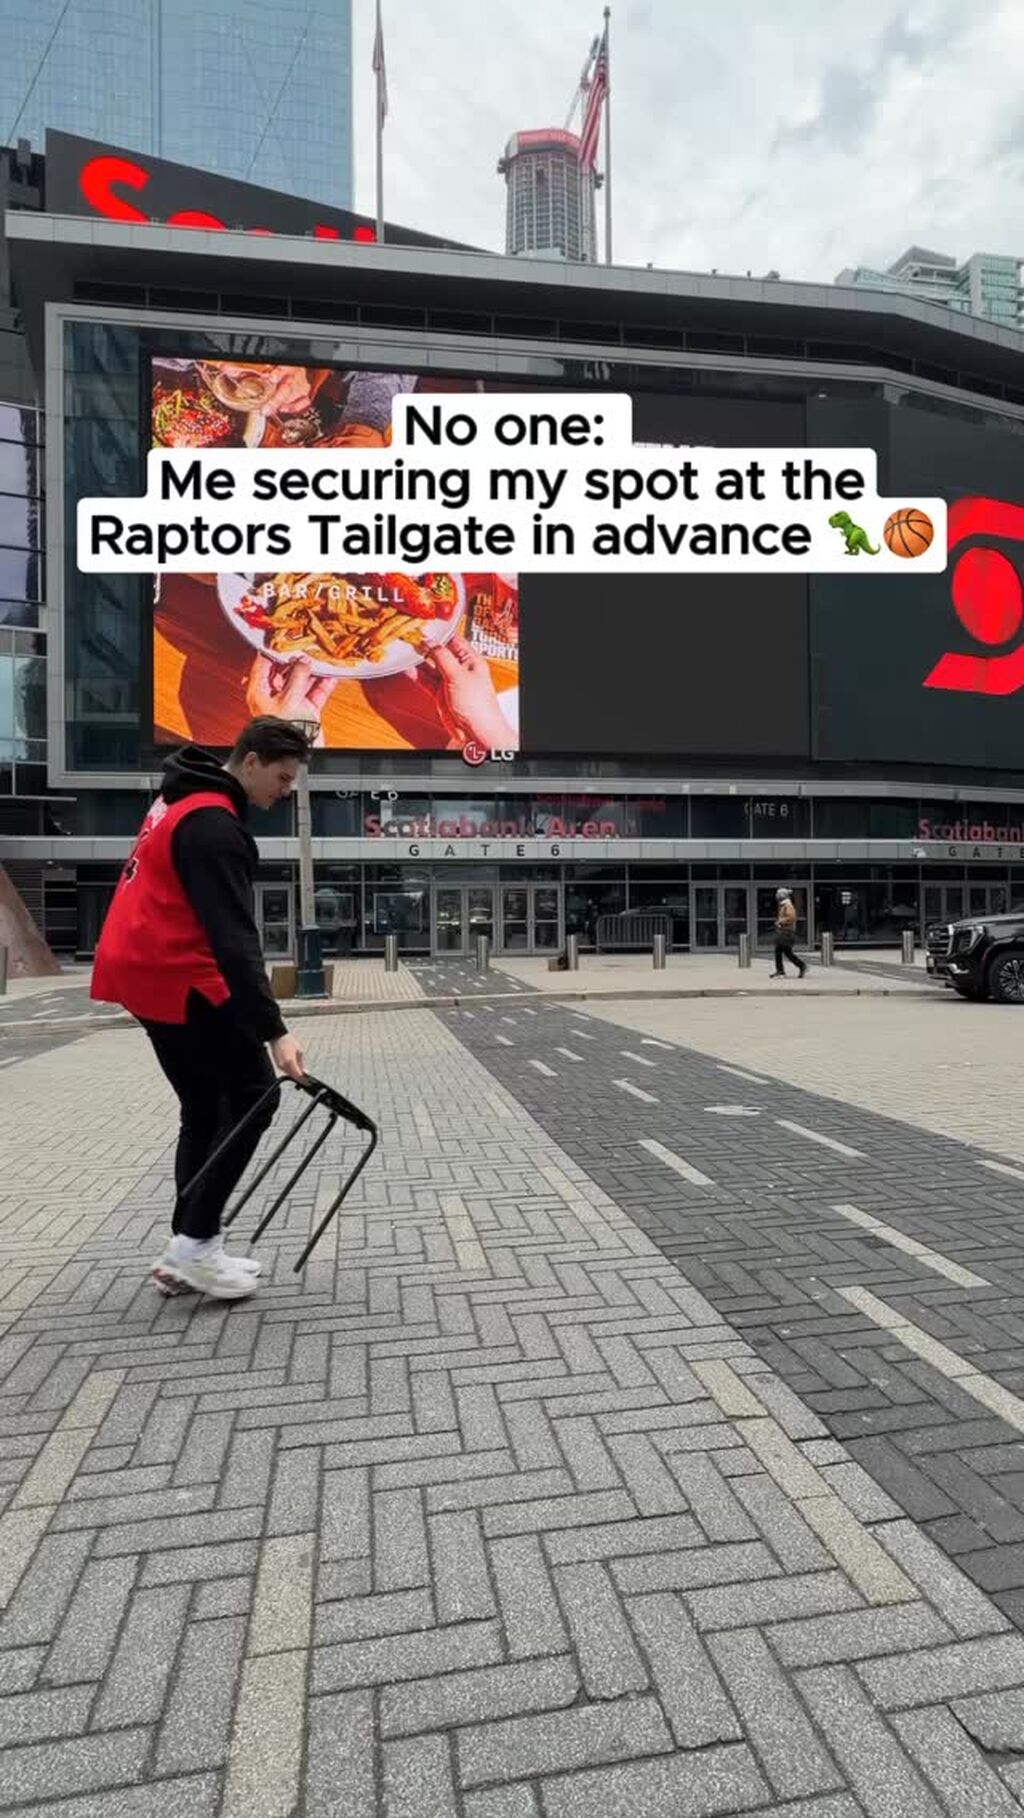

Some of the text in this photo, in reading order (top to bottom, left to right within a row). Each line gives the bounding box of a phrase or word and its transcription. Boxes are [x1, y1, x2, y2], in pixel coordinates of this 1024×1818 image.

[263, 582, 405, 603] BAR/GRILL
[490, 747, 515, 761] LG
[780, 803, 789, 817] 6
[364, 812, 536, 838] Scotiabank
[408, 844, 560, 857] GATE 6
